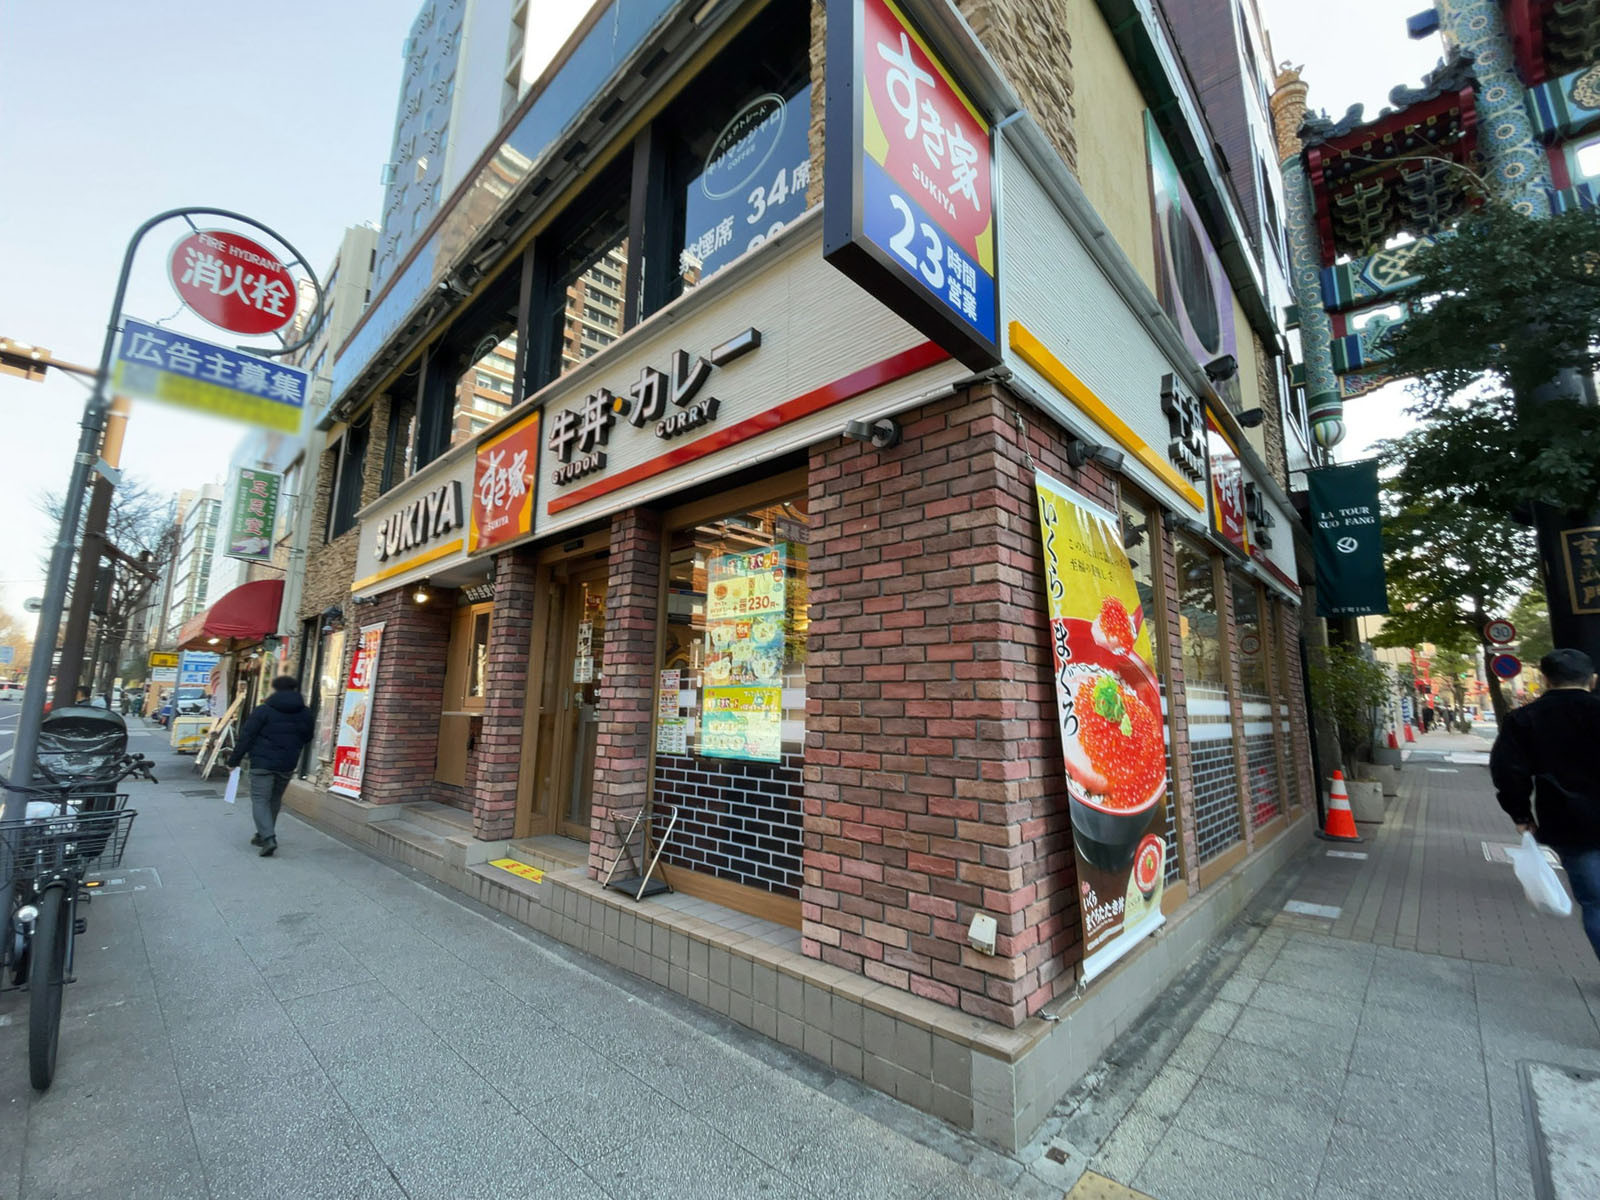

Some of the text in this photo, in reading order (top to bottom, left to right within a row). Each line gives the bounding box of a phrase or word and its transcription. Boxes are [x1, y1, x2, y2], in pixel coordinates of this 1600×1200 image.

[877, 32, 980, 211] すき家
[912, 163, 957, 220] SUKIYA
[199, 233, 283, 274] FIRE HYDRANT
[889, 194, 945, 289] 23
[181, 247, 290, 318] 消火栓
[947, 246, 977, 294] 時間
[947, 278, 978, 322] 営業
[126, 331, 302, 402] 広告主募集
[656, 397, 720, 440] CURRY
[479, 449, 528, 512] すき家
[552, 452, 606, 485] GYUDON
[374, 480, 463, 562] SUKIYA
[1339, 506, 1371, 517] TOUR
[1494, 625, 1510, 639] 30
[1082, 890, 1098, 912] いくら
[1085, 896, 1125, 932] まぐろたたき丼
